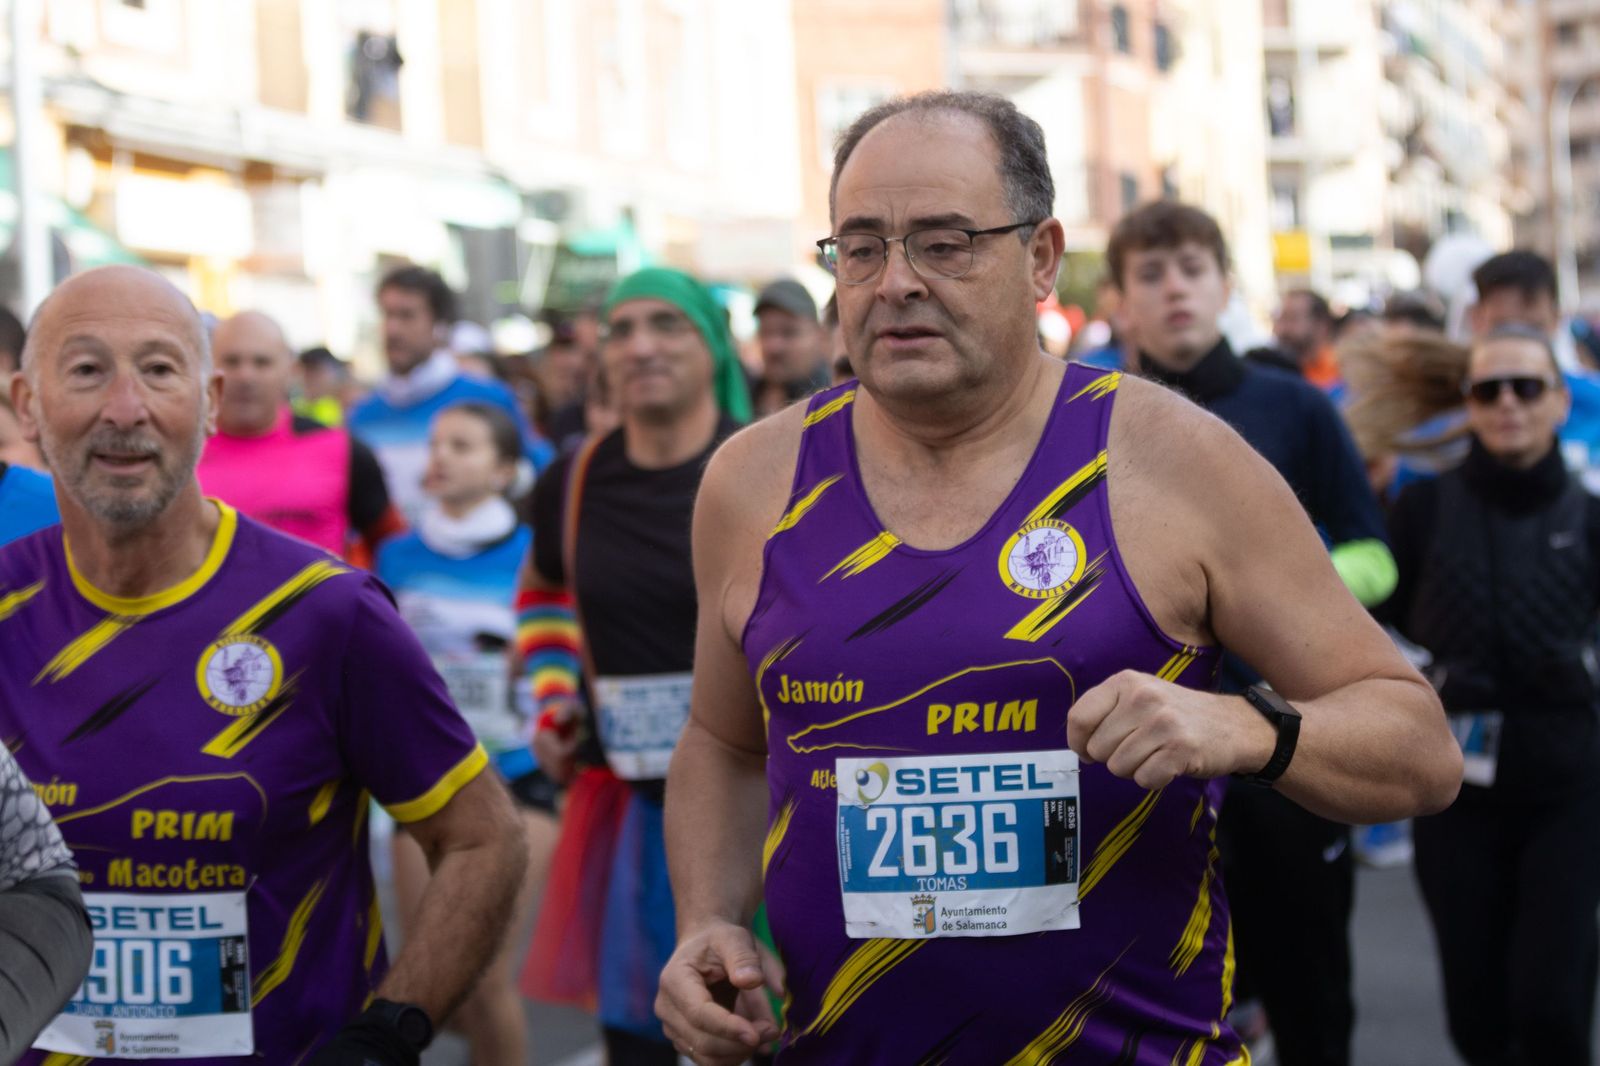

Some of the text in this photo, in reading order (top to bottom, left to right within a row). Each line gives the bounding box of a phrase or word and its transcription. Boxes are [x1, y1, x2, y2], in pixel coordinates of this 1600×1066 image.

[777, 673, 864, 704] Jamón
[926, 699, 1039, 736] PRIM
[895, 763, 1054, 796] SETEL
[131, 809, 235, 841] PRIM
[1067, 805, 1076, 829] 2636
[866, 802, 1020, 878] 2636
[107, 858, 246, 888] Macotera
[917, 876, 968, 892] TOMAS
[86, 905, 223, 931] SETEL
[941, 906, 1007, 919] Ayuntamiento
[942, 919, 1007, 931] de Salamanca
[69, 939, 193, 1005] 906
